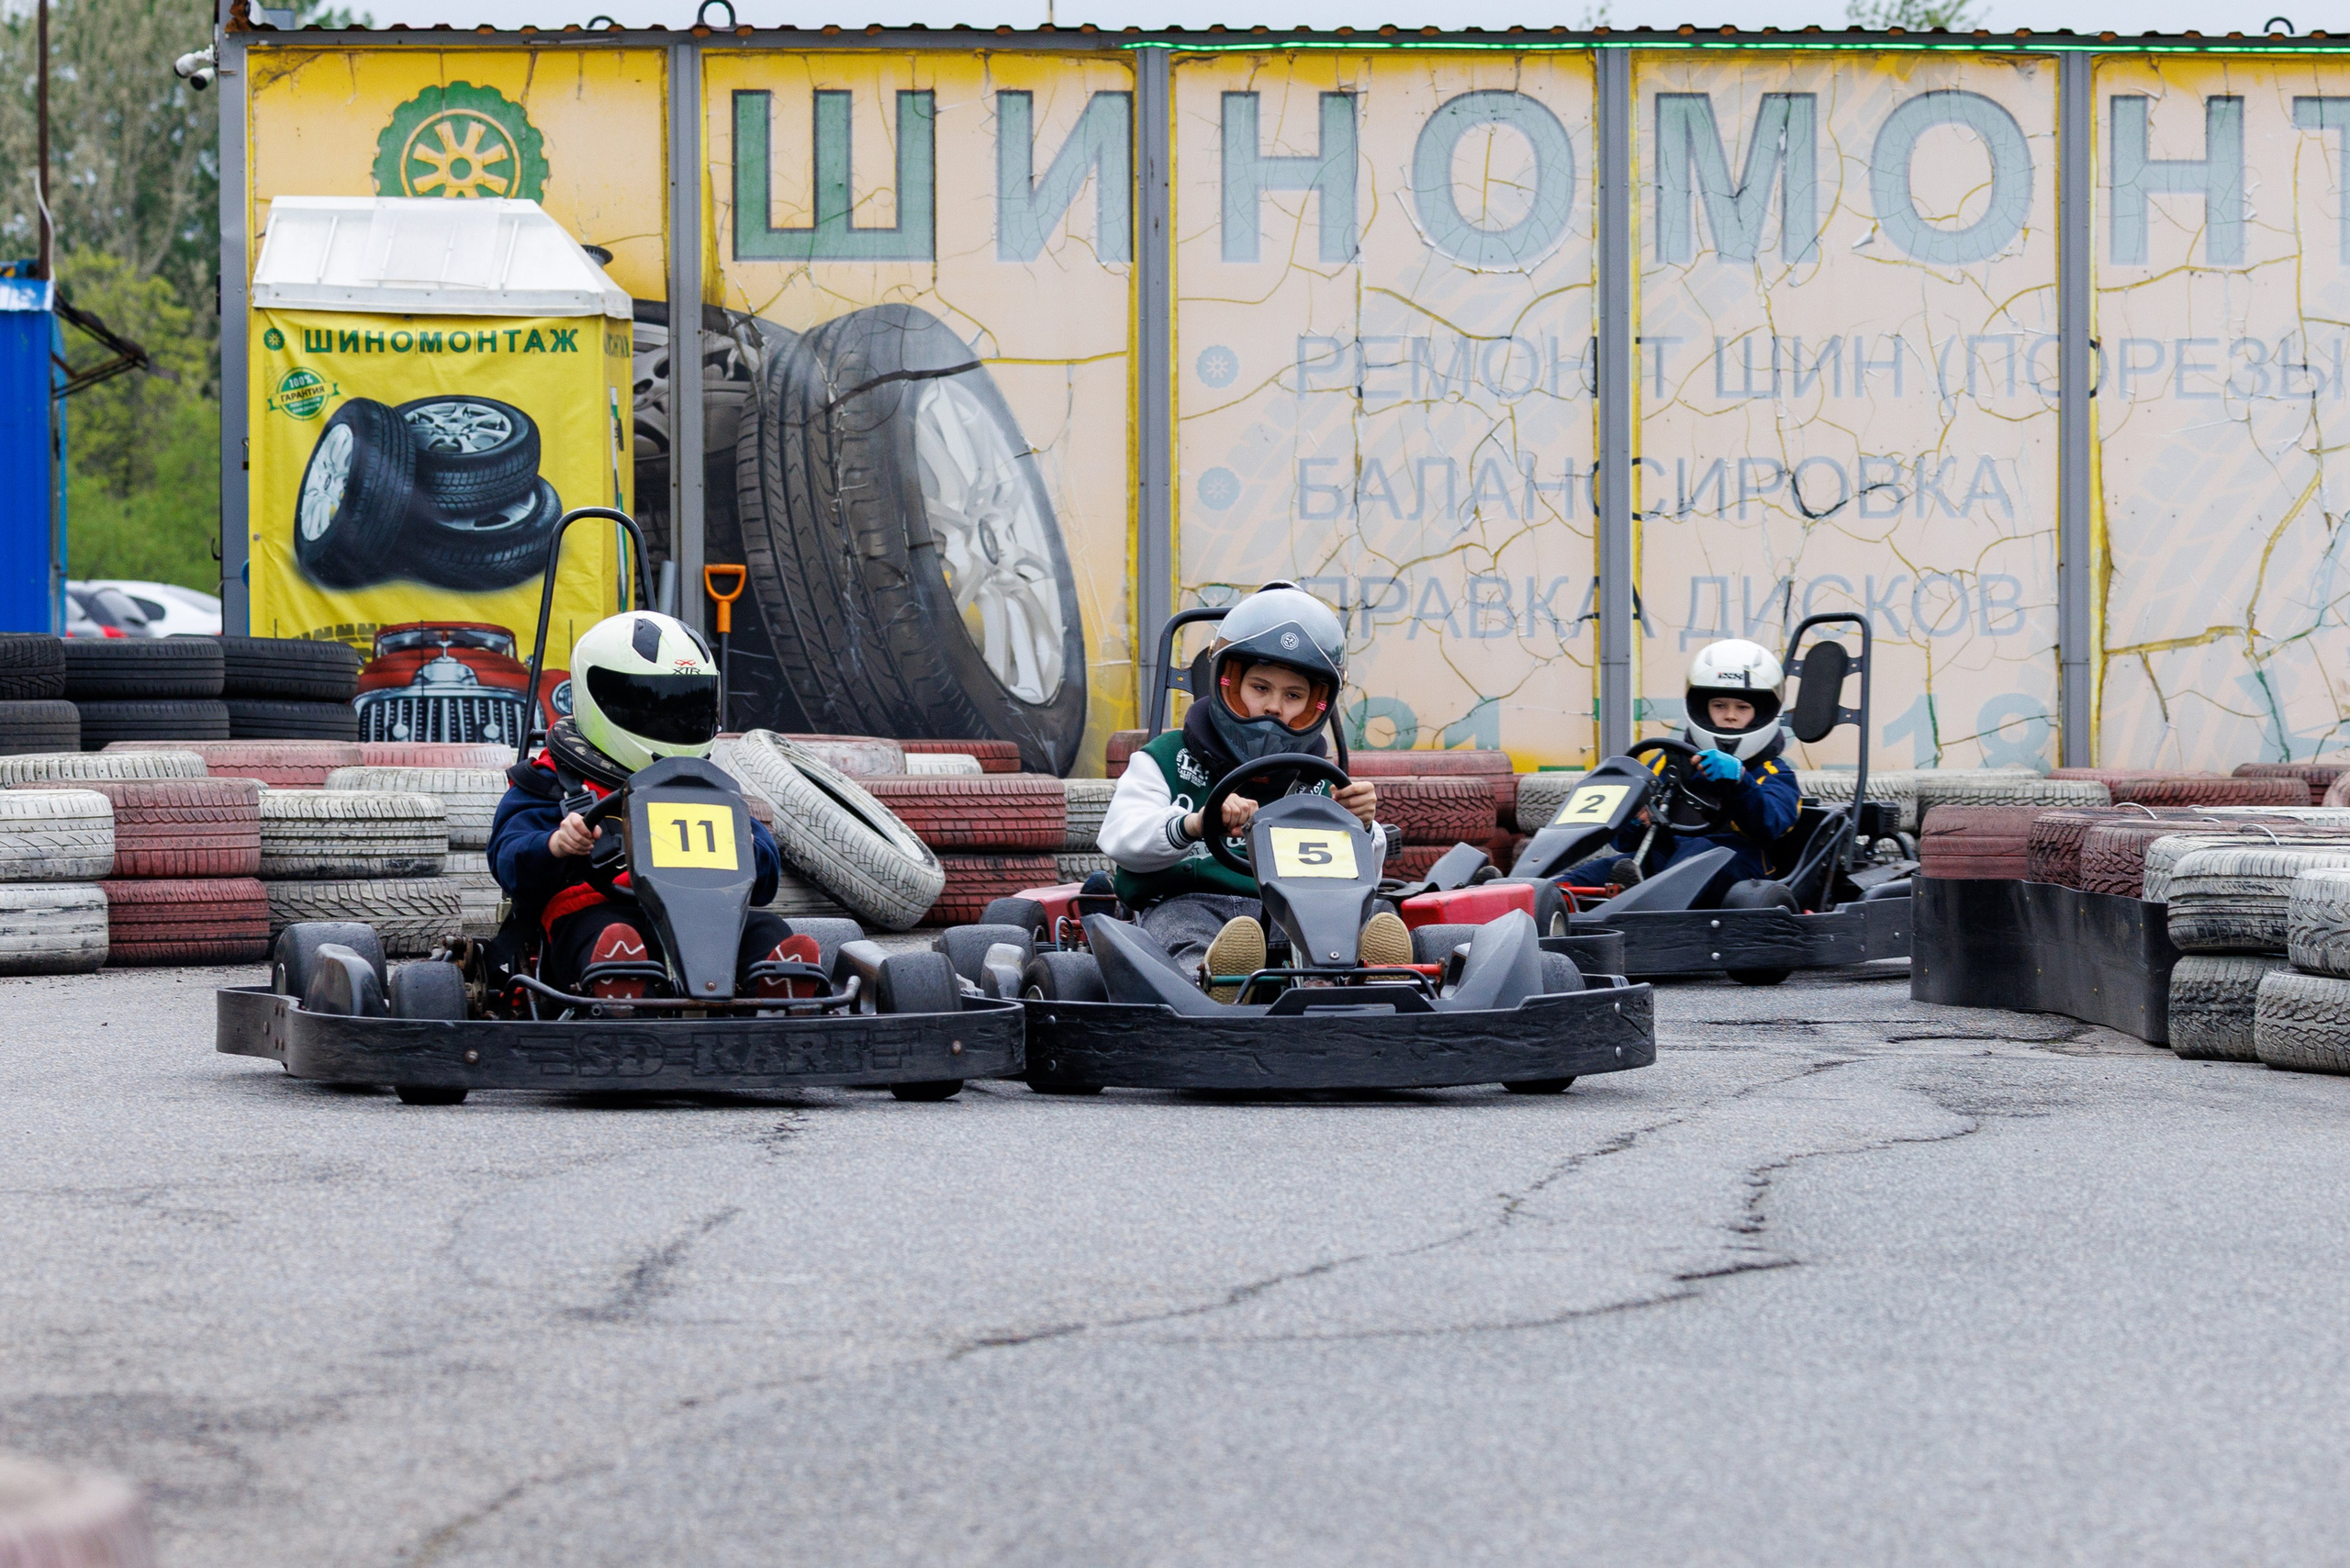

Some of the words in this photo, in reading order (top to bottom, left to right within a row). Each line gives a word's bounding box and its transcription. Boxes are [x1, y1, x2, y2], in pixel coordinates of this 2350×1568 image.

[304, 329, 578, 353] ШИНОМОНТАЖ
[1296, 335, 1684, 399] РЕМОНТ
[1714, 332, 1903, 399] ШИН
[288, 374, 314, 388] 100%
[280, 386, 325, 402] ГАРАНТИЯ
[1298, 455, 2015, 521] БАЛАНСИРОВКА
[1679, 574, 2028, 653] ДИСКОВ
[1575, 794, 1606, 814] 2
[671, 819, 716, 853] 11
[1297, 841, 1333, 866] 5
